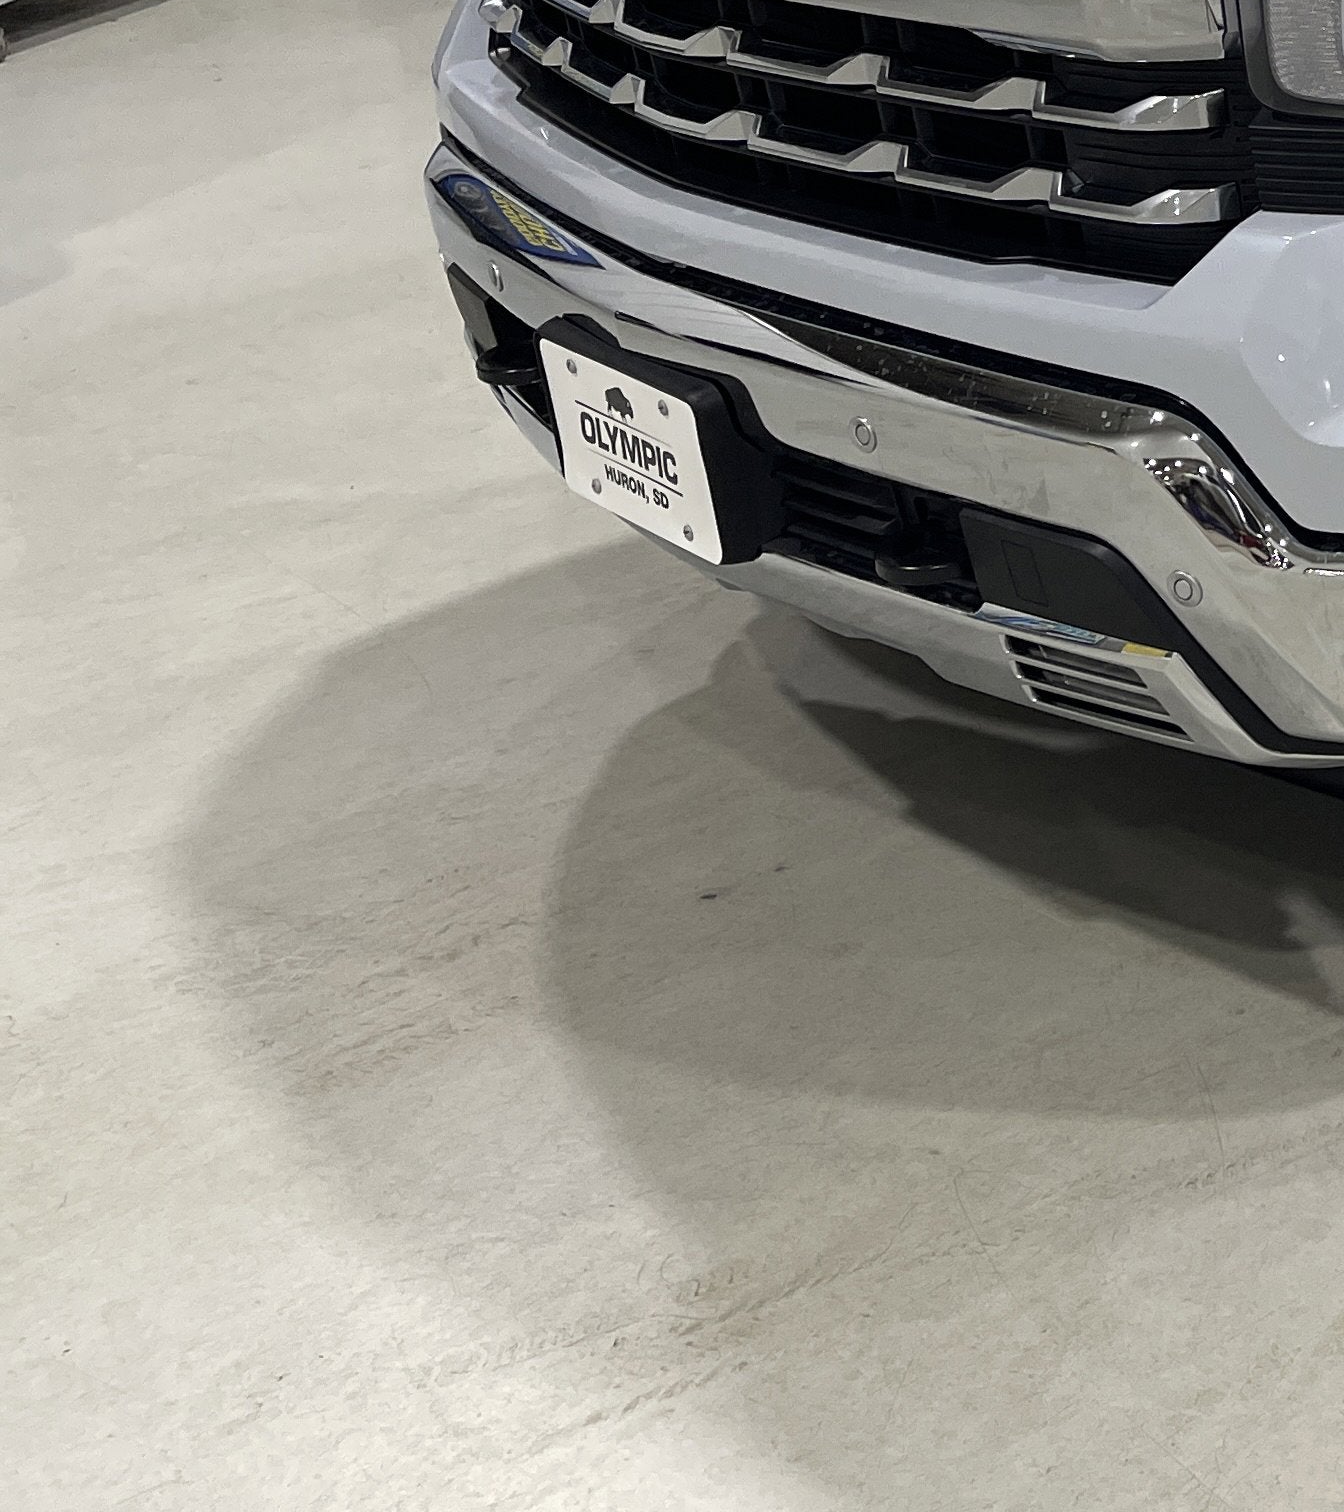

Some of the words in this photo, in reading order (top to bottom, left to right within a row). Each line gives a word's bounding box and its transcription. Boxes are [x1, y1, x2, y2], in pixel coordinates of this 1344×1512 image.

[580, 412, 678, 486] OLYMPIC
[604, 464, 650, 504] HURON,
[652, 488, 670, 510] SD
